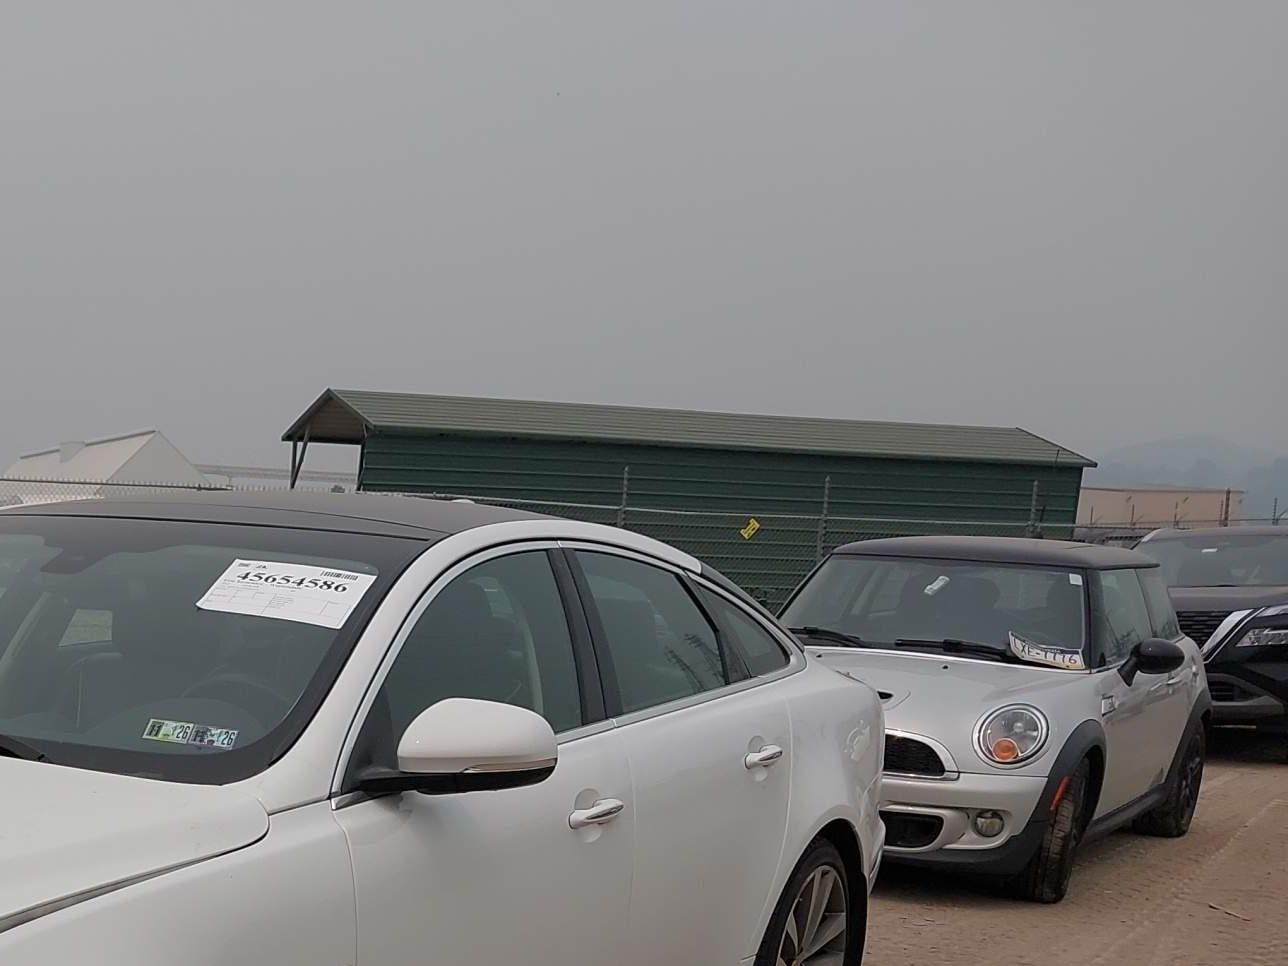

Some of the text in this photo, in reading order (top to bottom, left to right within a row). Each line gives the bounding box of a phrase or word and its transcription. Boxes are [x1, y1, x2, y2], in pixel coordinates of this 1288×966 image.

[237, 571, 349, 593] 45654586
[176, 725, 191, 739] 26
[221, 730, 236, 746] 26
